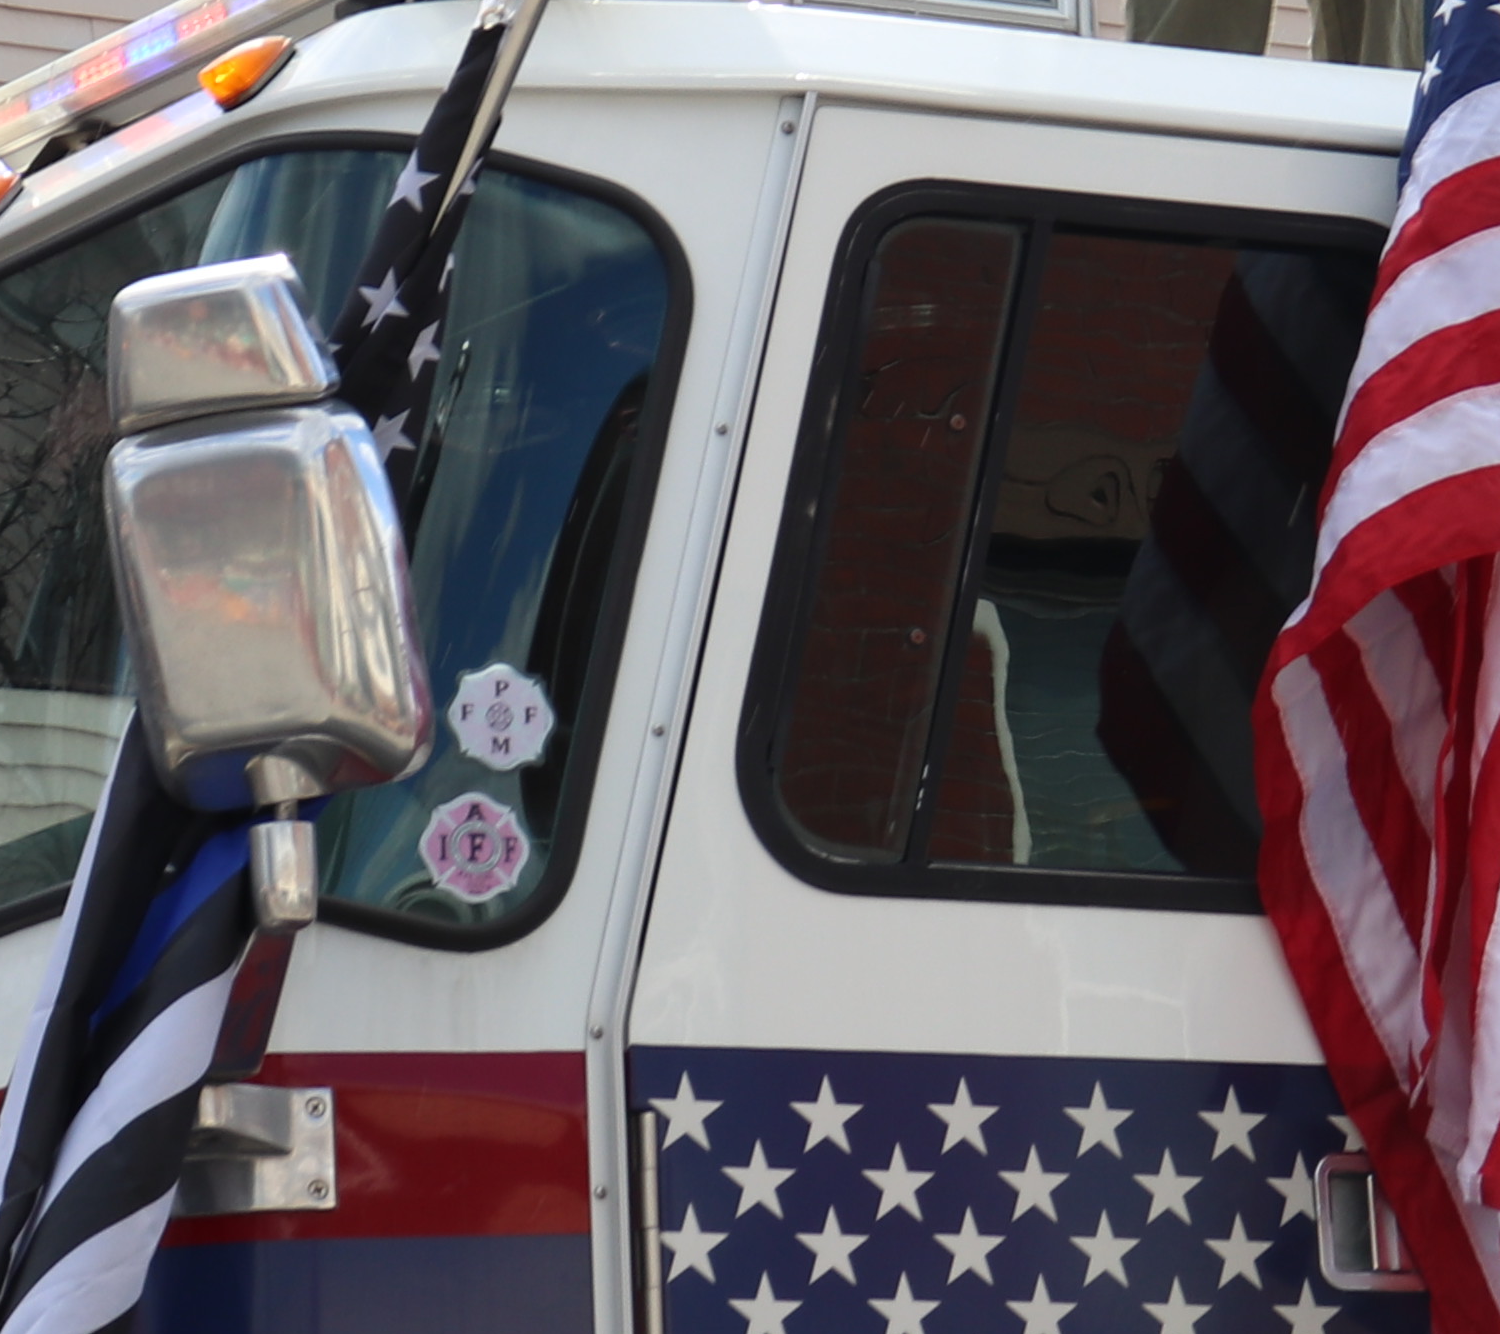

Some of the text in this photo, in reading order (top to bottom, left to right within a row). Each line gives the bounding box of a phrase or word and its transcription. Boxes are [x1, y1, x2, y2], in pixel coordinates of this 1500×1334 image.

[495, 680, 510, 698] P
[461, 703, 538, 725] F F
[491, 736, 511, 755] M
[465, 803, 485, 823] A
[467, 832, 486, 863] F
[504, 837, 518, 864] F
